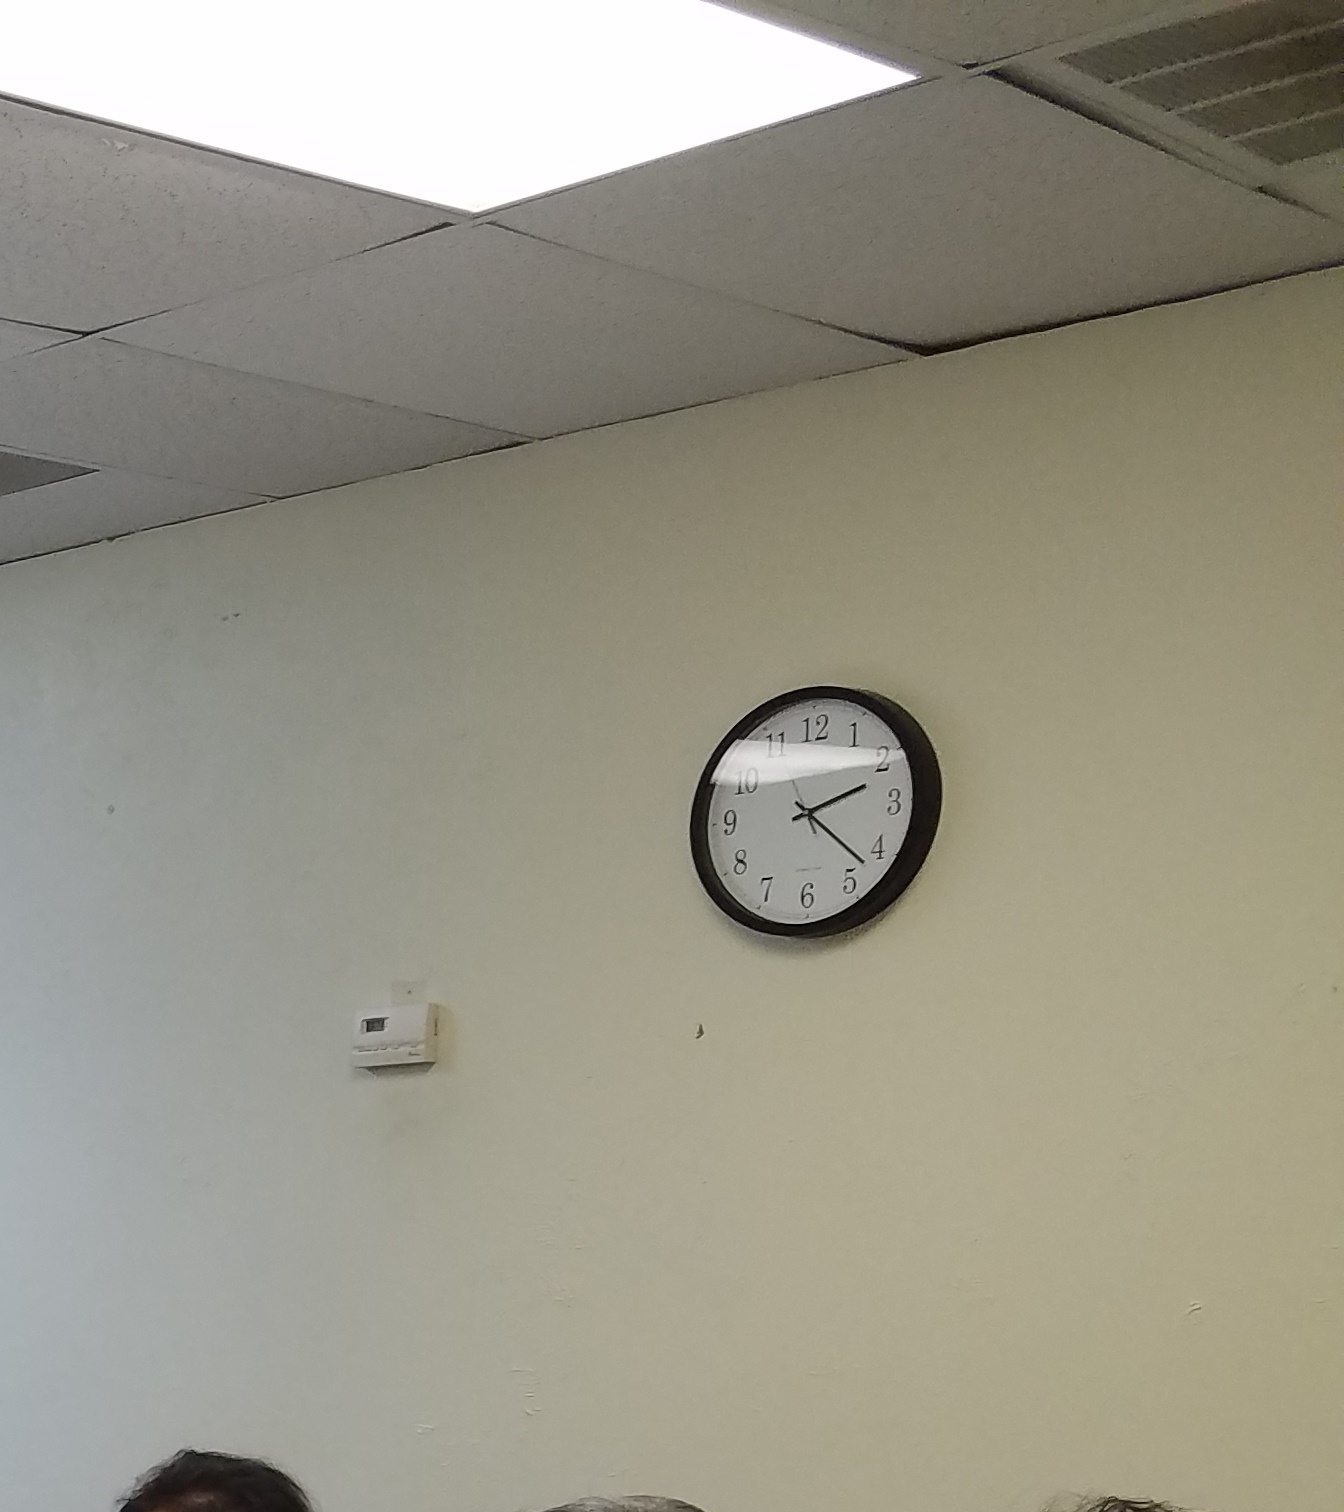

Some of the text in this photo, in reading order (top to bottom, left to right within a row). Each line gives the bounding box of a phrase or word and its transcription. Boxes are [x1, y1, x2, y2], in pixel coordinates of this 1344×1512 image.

[801, 714, 829, 742] 12
[850, 722, 858, 748] 1
[766, 732, 786, 758] 11
[874, 746, 890, 772] 2
[735, 768, 759, 795] 10
[887, 788, 902, 815] 3
[723, 810, 737, 835] 9
[871, 834, 885, 860] 4
[733, 849, 747, 875] 8
[760, 877, 773, 902] 7
[843, 867, 857, 894] 5
[800, 883, 814, 908] 6
